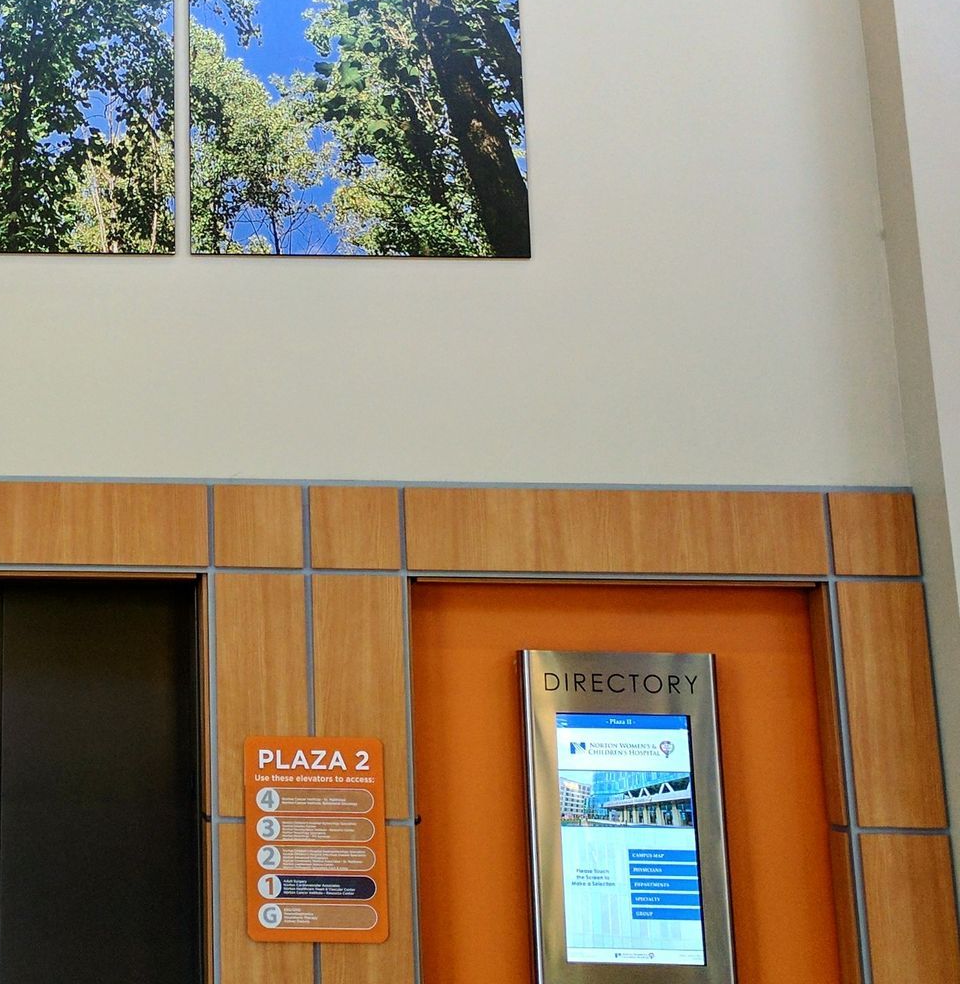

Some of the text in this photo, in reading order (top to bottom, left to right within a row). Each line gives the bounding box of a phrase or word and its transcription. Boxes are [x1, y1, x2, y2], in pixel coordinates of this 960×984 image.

[544, 672, 698, 694] DIRECTORY
[258, 749, 370, 771] PLAZA 2
[254, 774, 375, 784] Use these elevators to access:
[260, 790, 274, 808] 4
[262, 819, 275, 837] 3
[262, 847, 275, 865] 2
[265, 877, 274, 895] 1
[263, 906, 277, 924] G
